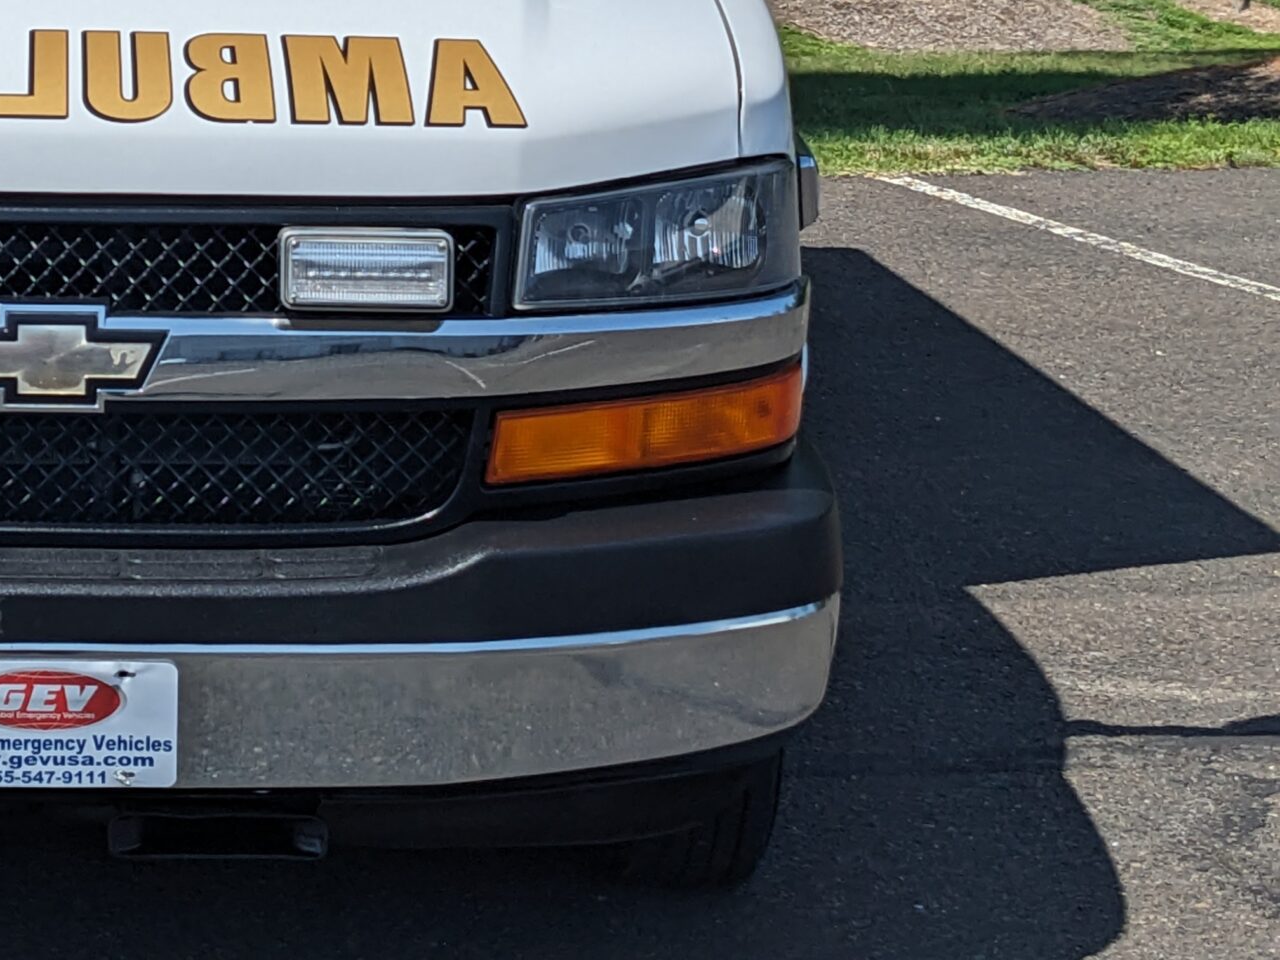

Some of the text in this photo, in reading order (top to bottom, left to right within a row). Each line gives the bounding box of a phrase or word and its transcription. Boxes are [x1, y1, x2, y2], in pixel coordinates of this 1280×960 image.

[16, 711, 61, 721] Emergency
[62, 711, 95, 719] Vehicles
[92, 735, 173, 752] Vehicles
